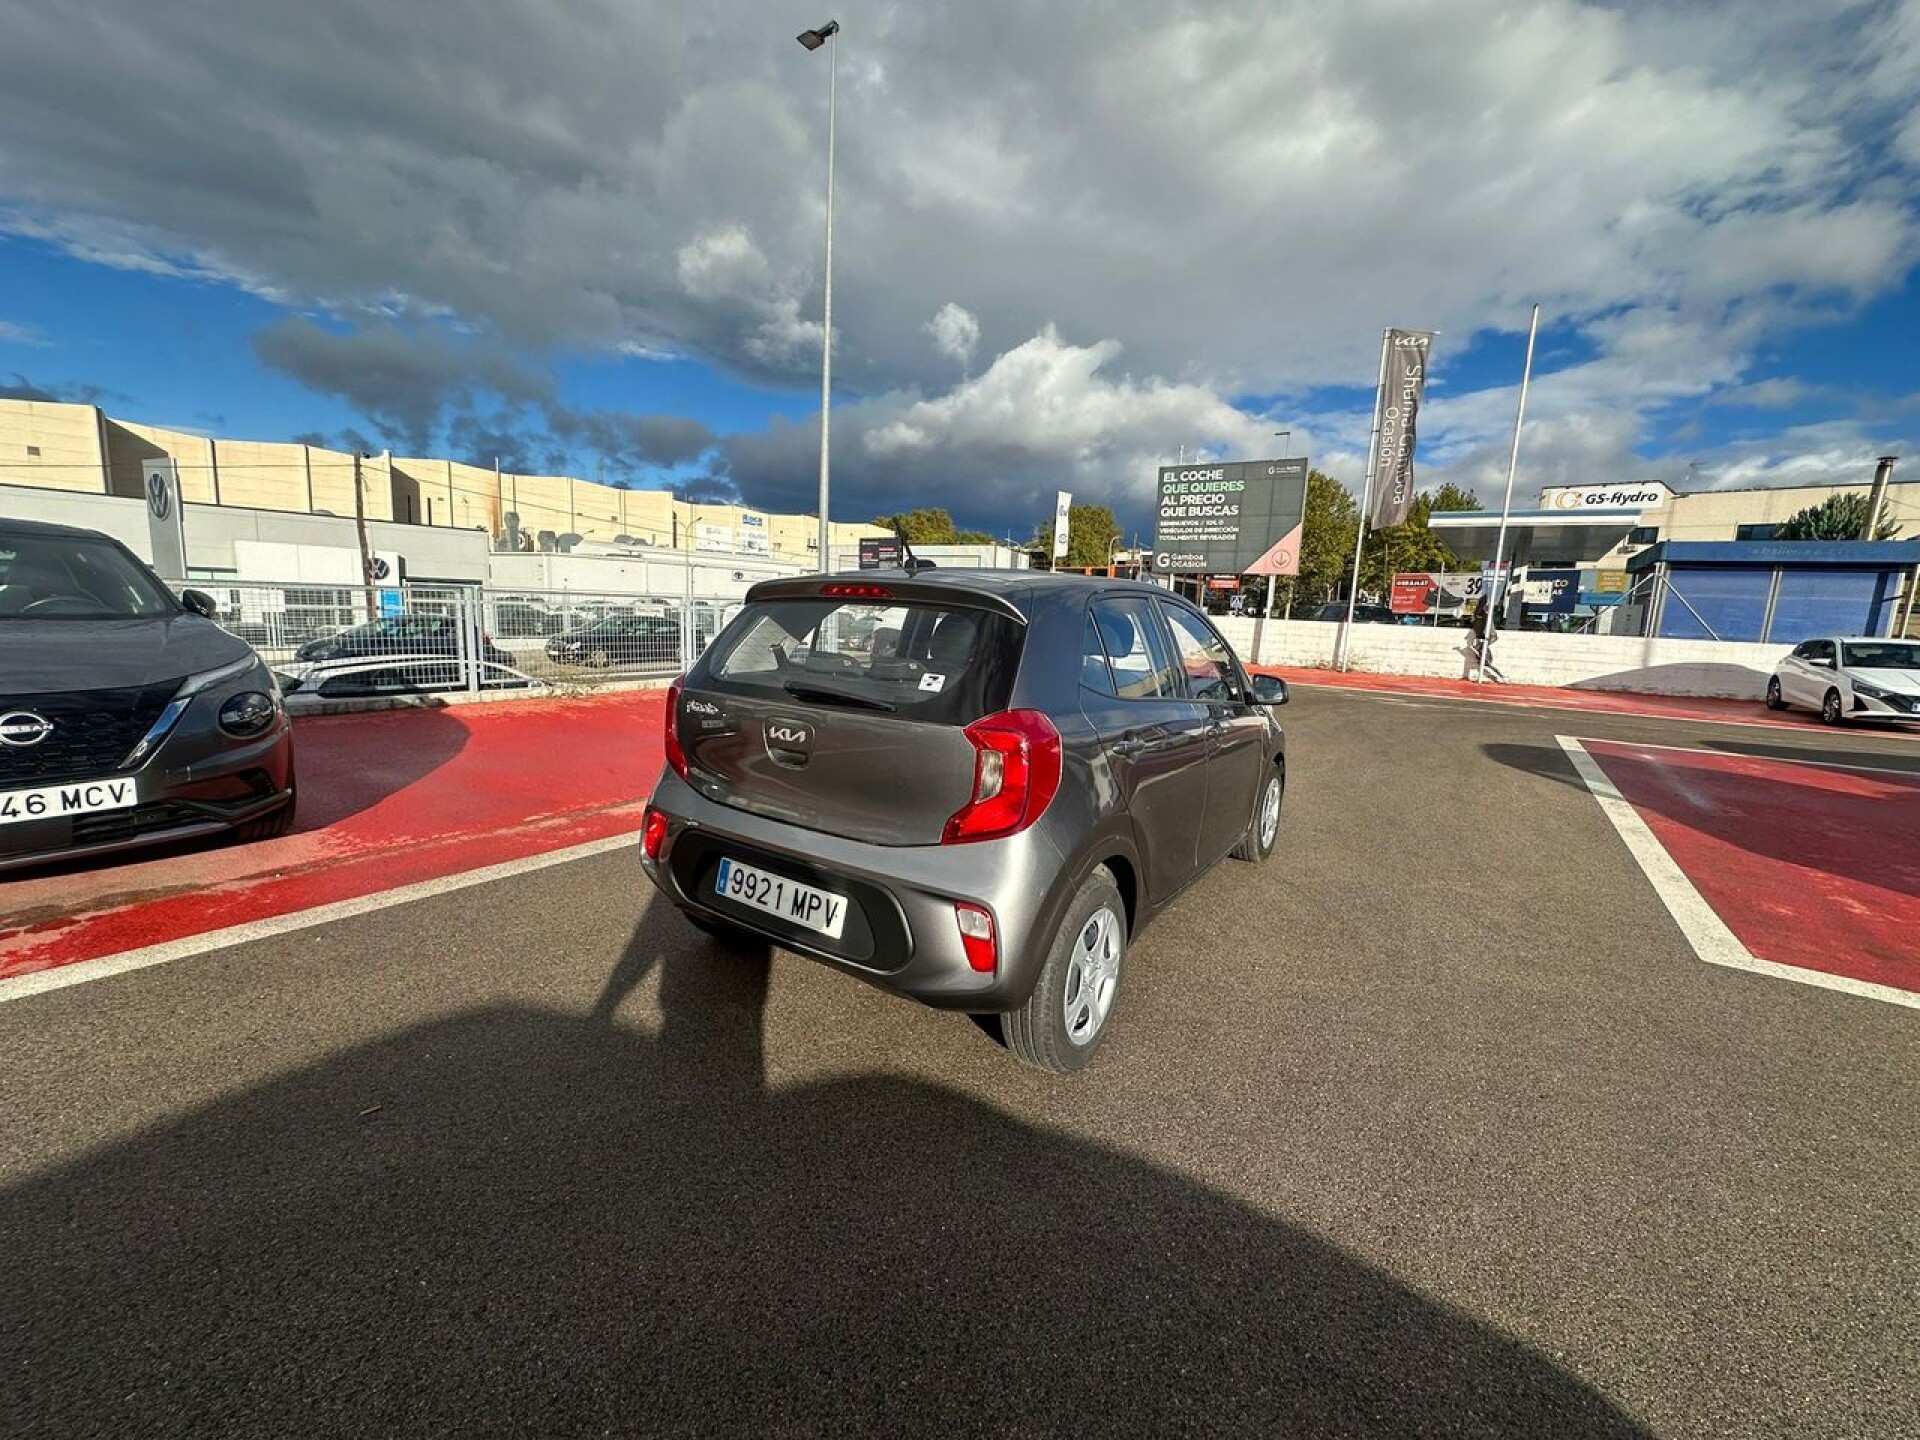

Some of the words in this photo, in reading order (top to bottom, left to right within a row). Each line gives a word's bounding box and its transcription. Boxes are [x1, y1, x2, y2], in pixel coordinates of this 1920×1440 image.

[1380, 407, 1399, 467] Ocasión
[1163, 472, 1178, 482] EL
[1180, 469, 1224, 481] COCHE
[1163, 484, 1188, 494] QUE
[1191, 480, 1245, 492] QUIERES
[1161, 495, 1178, 505] AL
[1180, 493, 1225, 504] PRECIO
[1585, 491, 1658, 505] GS-Hydro
[1160, 506, 1186, 517] QUE
[1188, 505, 1239, 516] BUSCAS
[1157, 552, 1170, 568] G
[1171, 552, 1204, 560] Gamboa
[1, 793, 46, 817] 46
[61, 783, 126, 811] MCV
[731, 868, 784, 910] 9921
[791, 888, 839, 928] MPV
